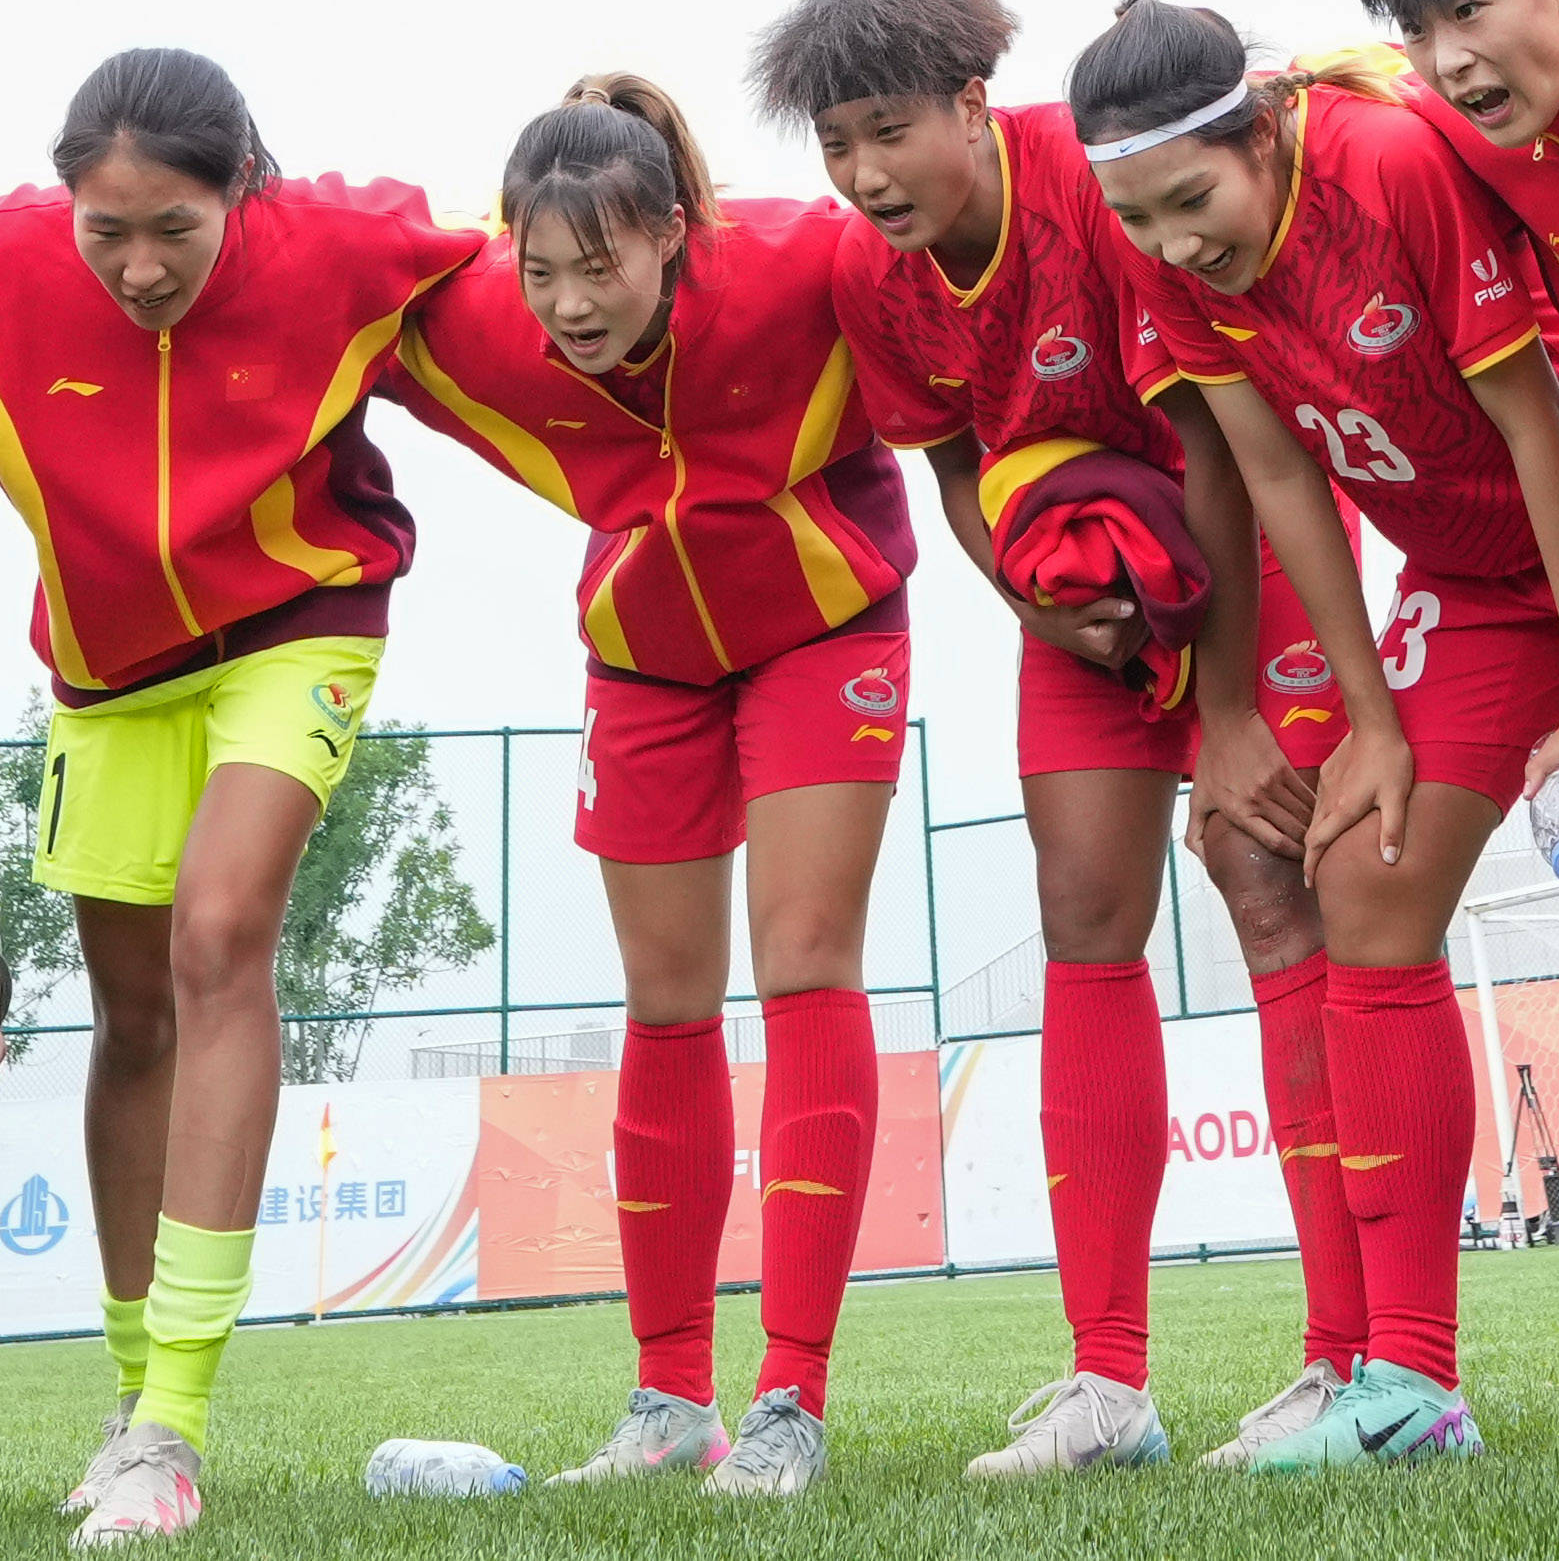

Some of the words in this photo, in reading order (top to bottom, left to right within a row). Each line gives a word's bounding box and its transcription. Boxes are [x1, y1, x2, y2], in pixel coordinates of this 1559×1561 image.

[1474, 277, 1514, 307] FISU
[1294, 403, 1416, 483] 23
[256, 1179, 406, 1226] 建设集团
